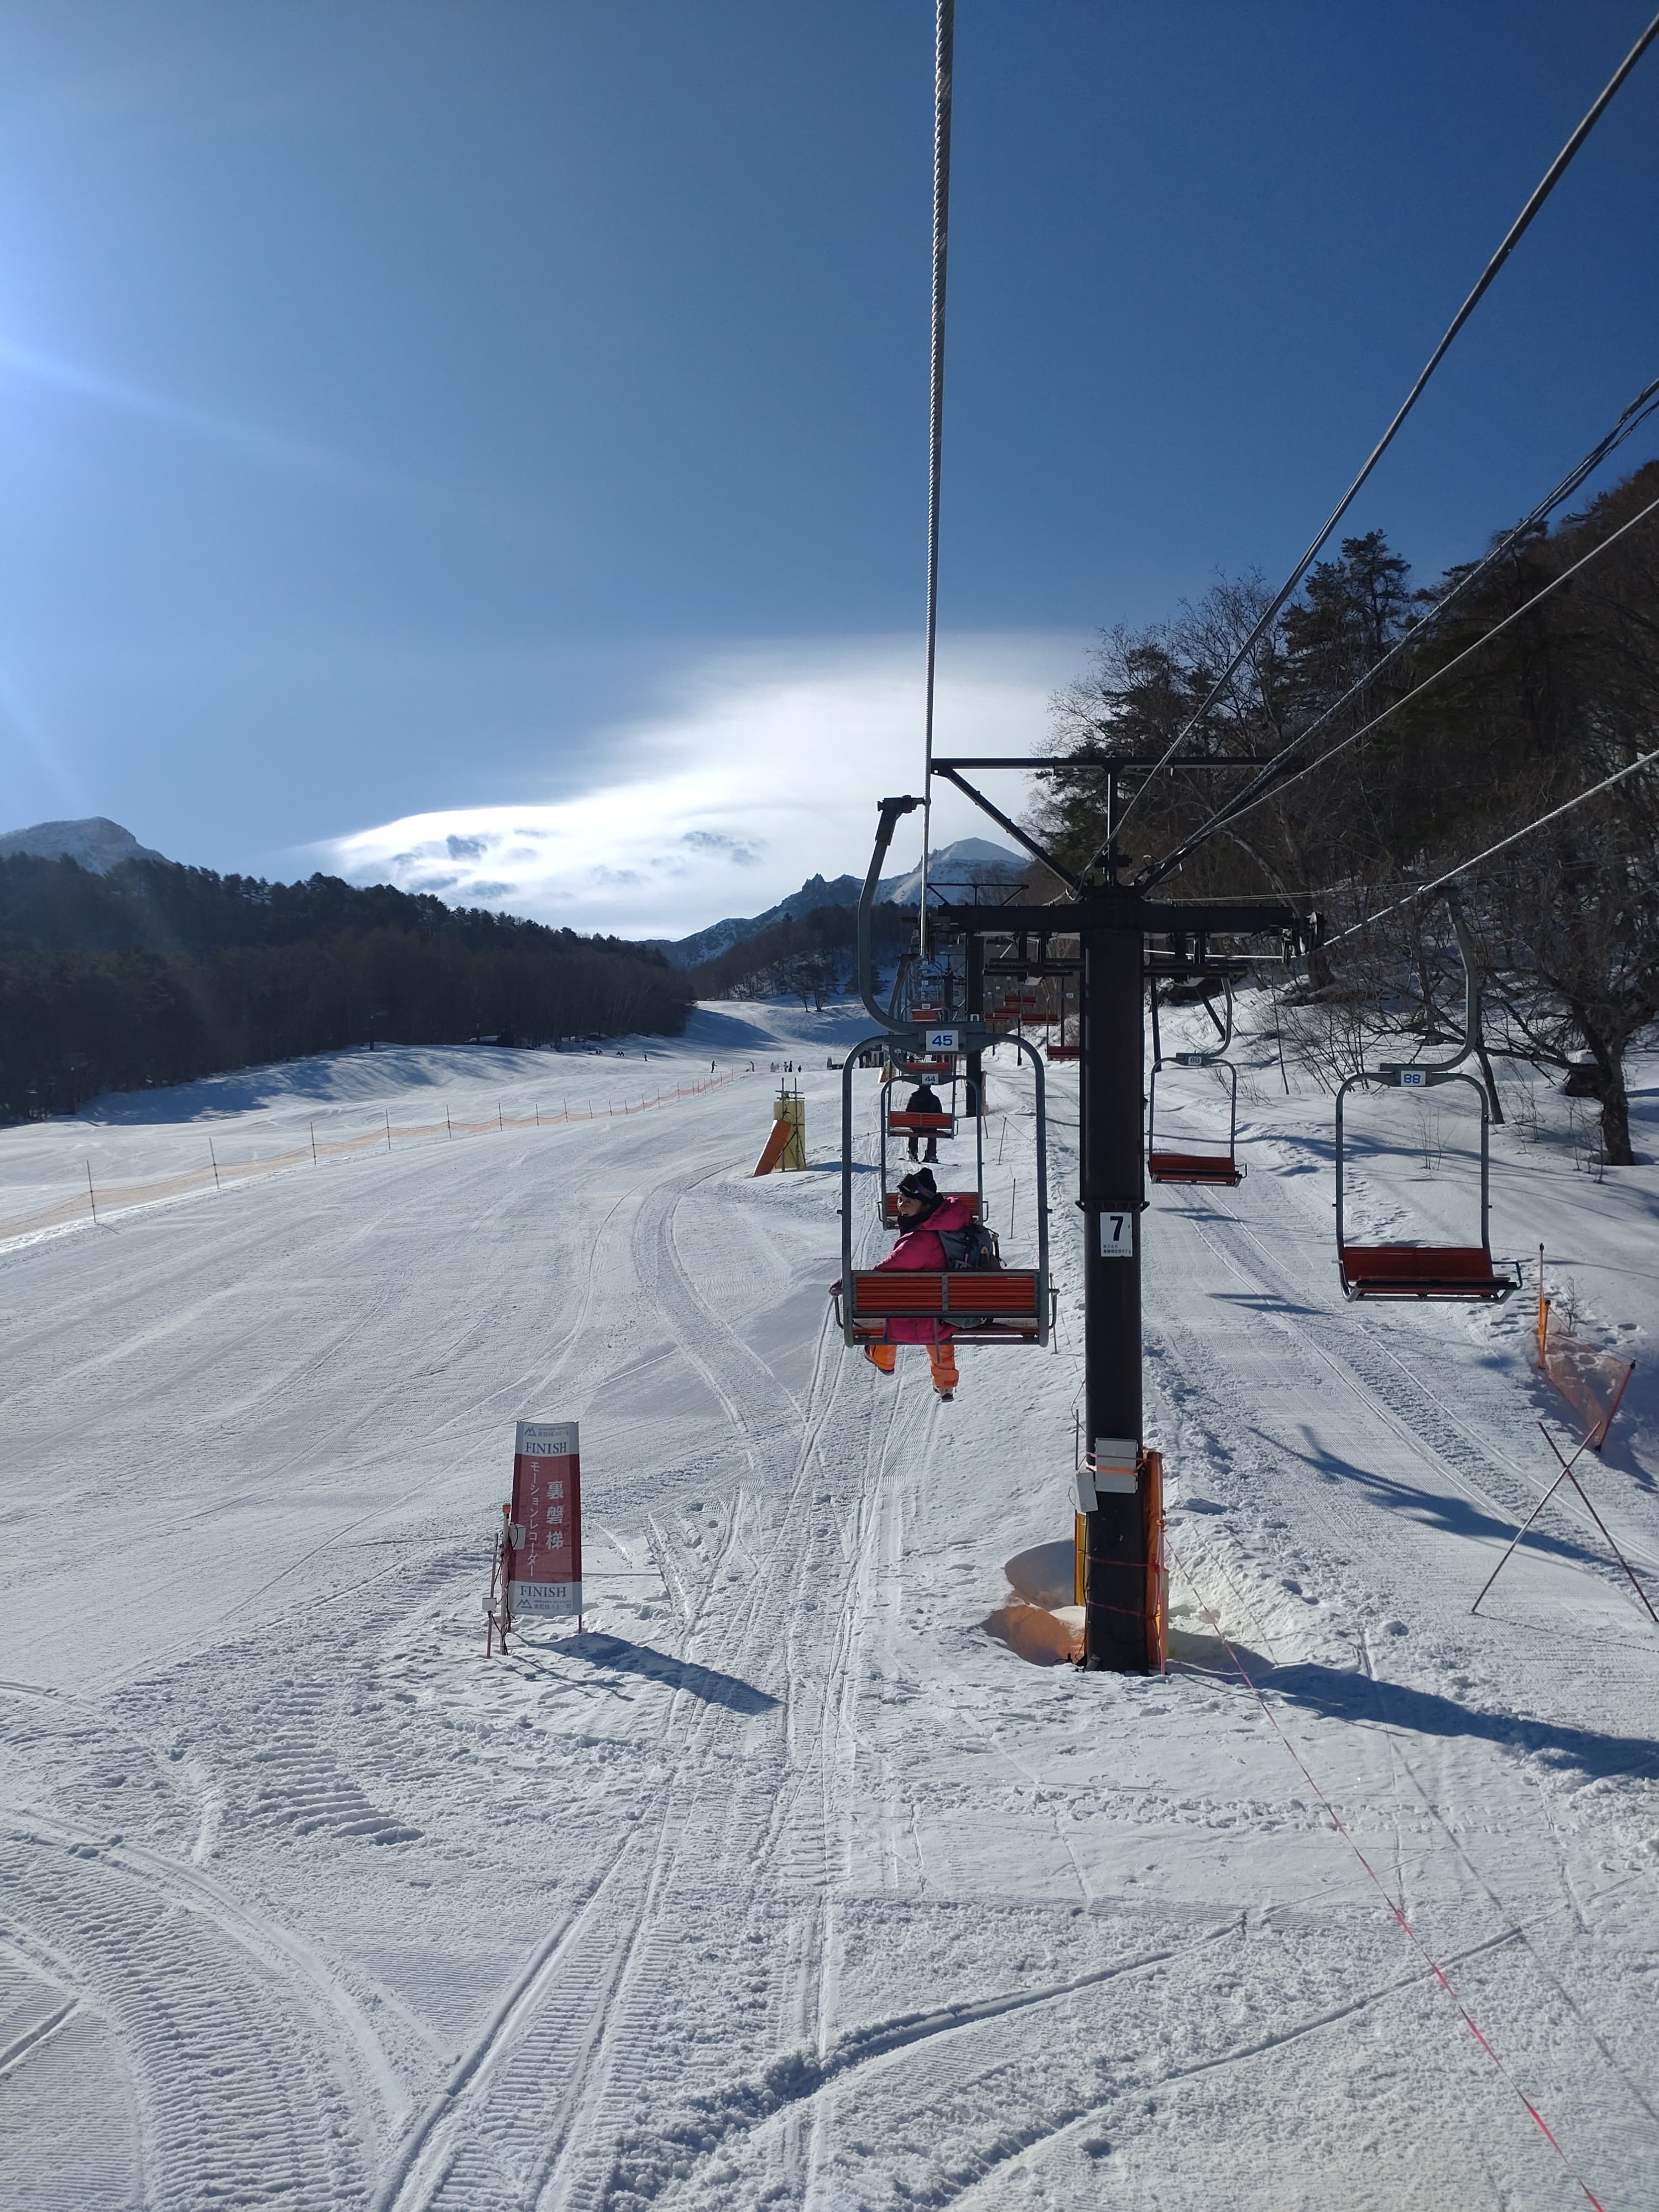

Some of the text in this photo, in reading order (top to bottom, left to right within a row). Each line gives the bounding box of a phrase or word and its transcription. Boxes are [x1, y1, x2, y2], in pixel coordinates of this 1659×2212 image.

[932, 1035, 953, 1046] 45
[1404, 1073, 1421, 1084] 88
[1110, 1216, 1124, 1241] 7
[526, 1442, 567, 1454] FINISH
[528, 1462, 540, 1577] モーションレコーダー
[546, 1481, 564, 1550] 裏磐梯
[520, 1585, 567, 1598] FINISH
